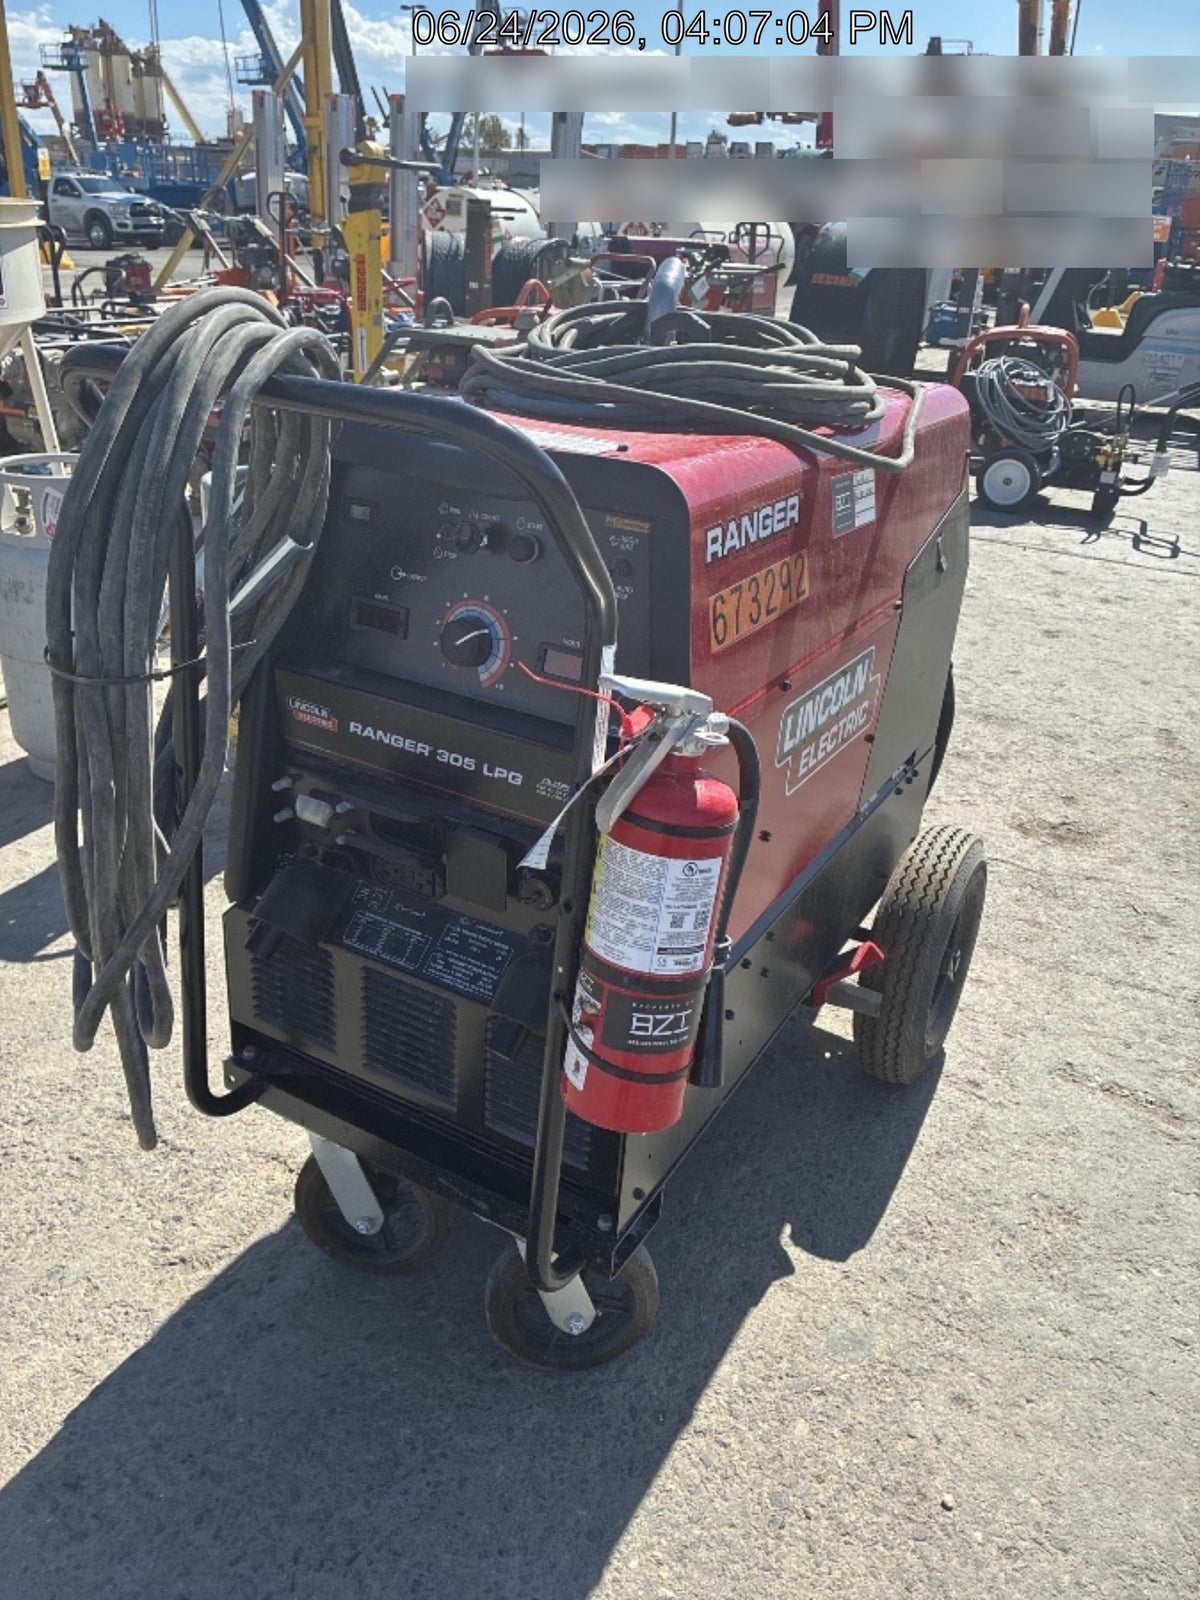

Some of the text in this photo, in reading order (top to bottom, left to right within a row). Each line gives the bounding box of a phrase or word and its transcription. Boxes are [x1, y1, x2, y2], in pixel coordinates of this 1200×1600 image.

[706, 494, 800, 564] RANGER
[712, 552, 805, 646] 673292
[783, 659, 870, 753] LINCOLN
[798, 700, 869, 777] ELECTRIC
[350, 721, 431, 757] RANGER
[436, 749, 476, 771] 305
[483, 763, 524, 786] LPG
